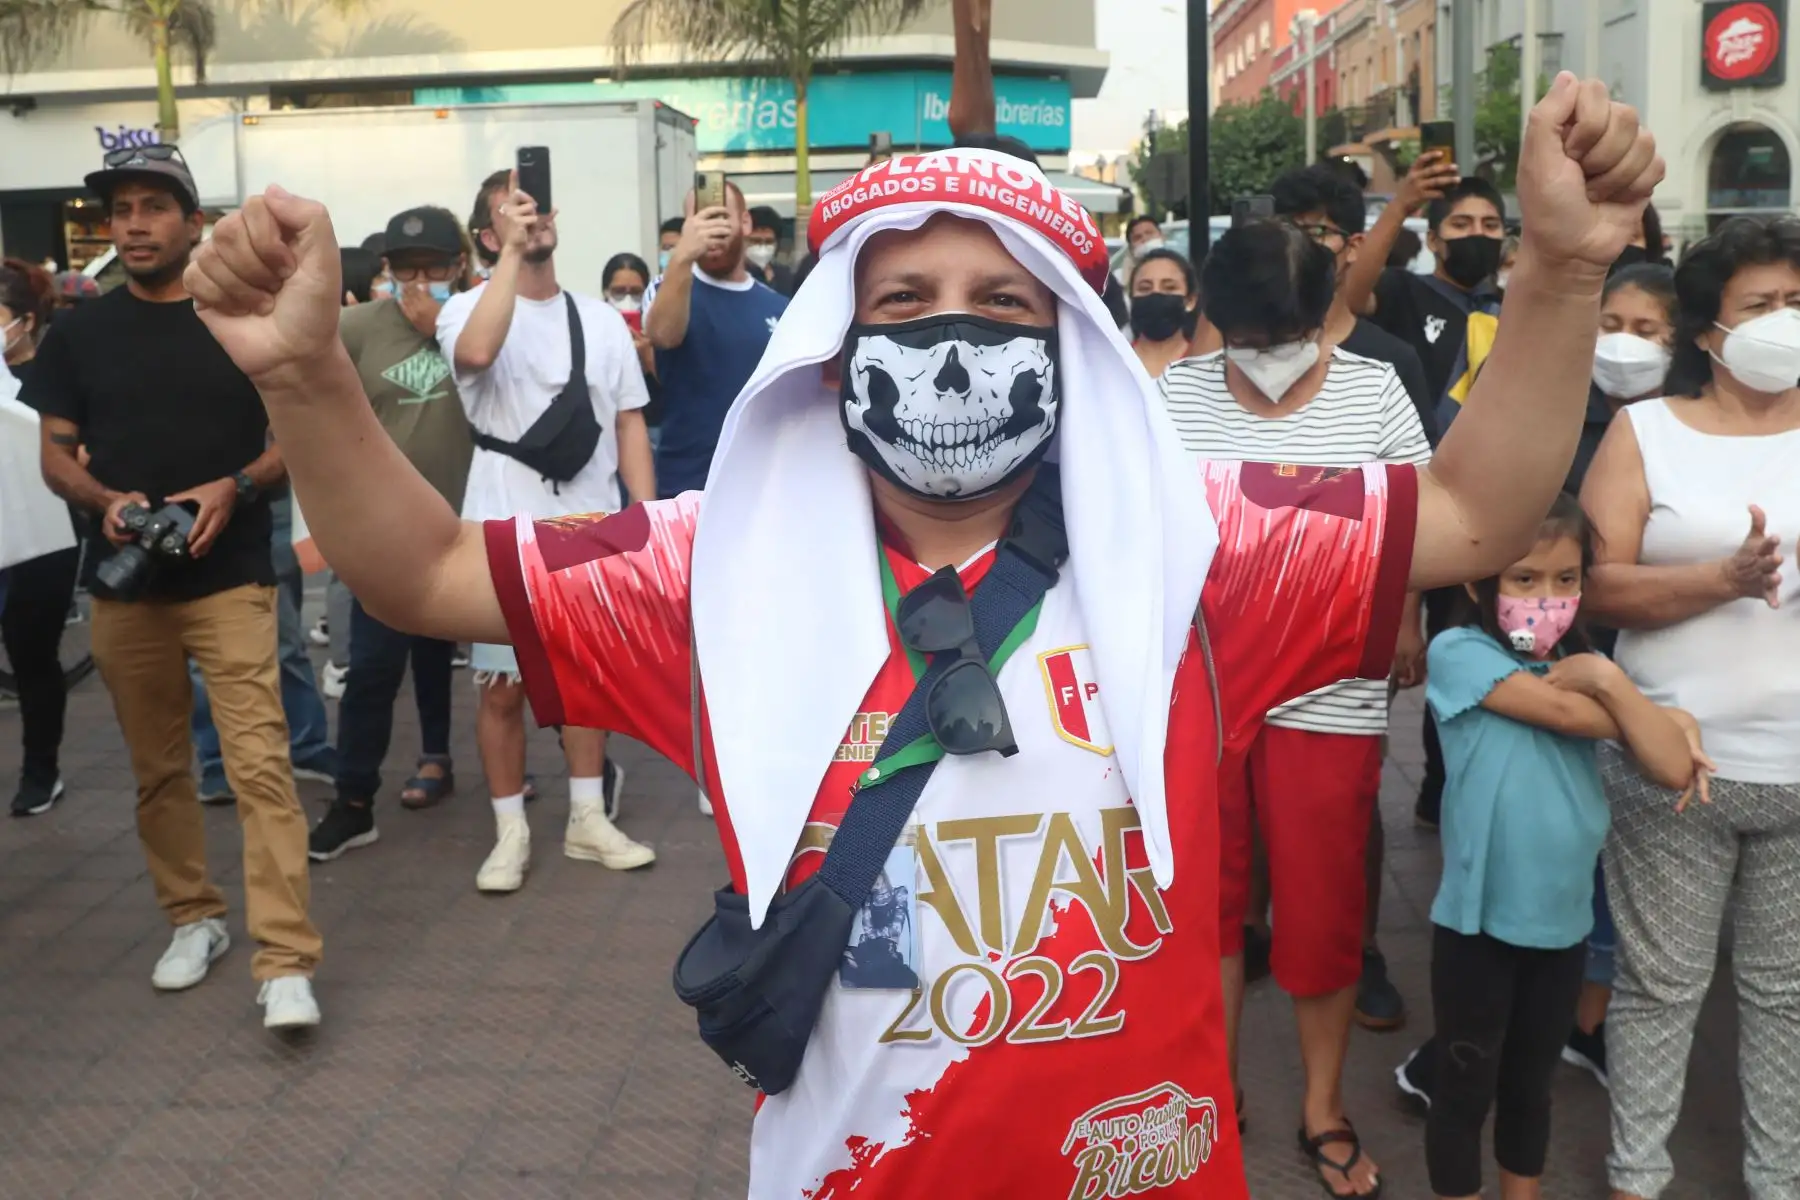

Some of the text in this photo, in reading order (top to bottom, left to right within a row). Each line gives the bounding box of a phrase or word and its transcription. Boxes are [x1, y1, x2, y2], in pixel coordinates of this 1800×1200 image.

[822, 176, 937, 223] ABOGADOS
[944, 176, 960, 193] E
[968, 178, 1094, 255] INGENIEROS
[783, 803, 1174, 962] ATAR
[877, 949, 1127, 1048] 2022
[1068, 1109, 1212, 1200] Bicolor
[1077, 1094, 1187, 1145] EL AUTO Pasión
[1139, 1127, 1165, 1148] POR
